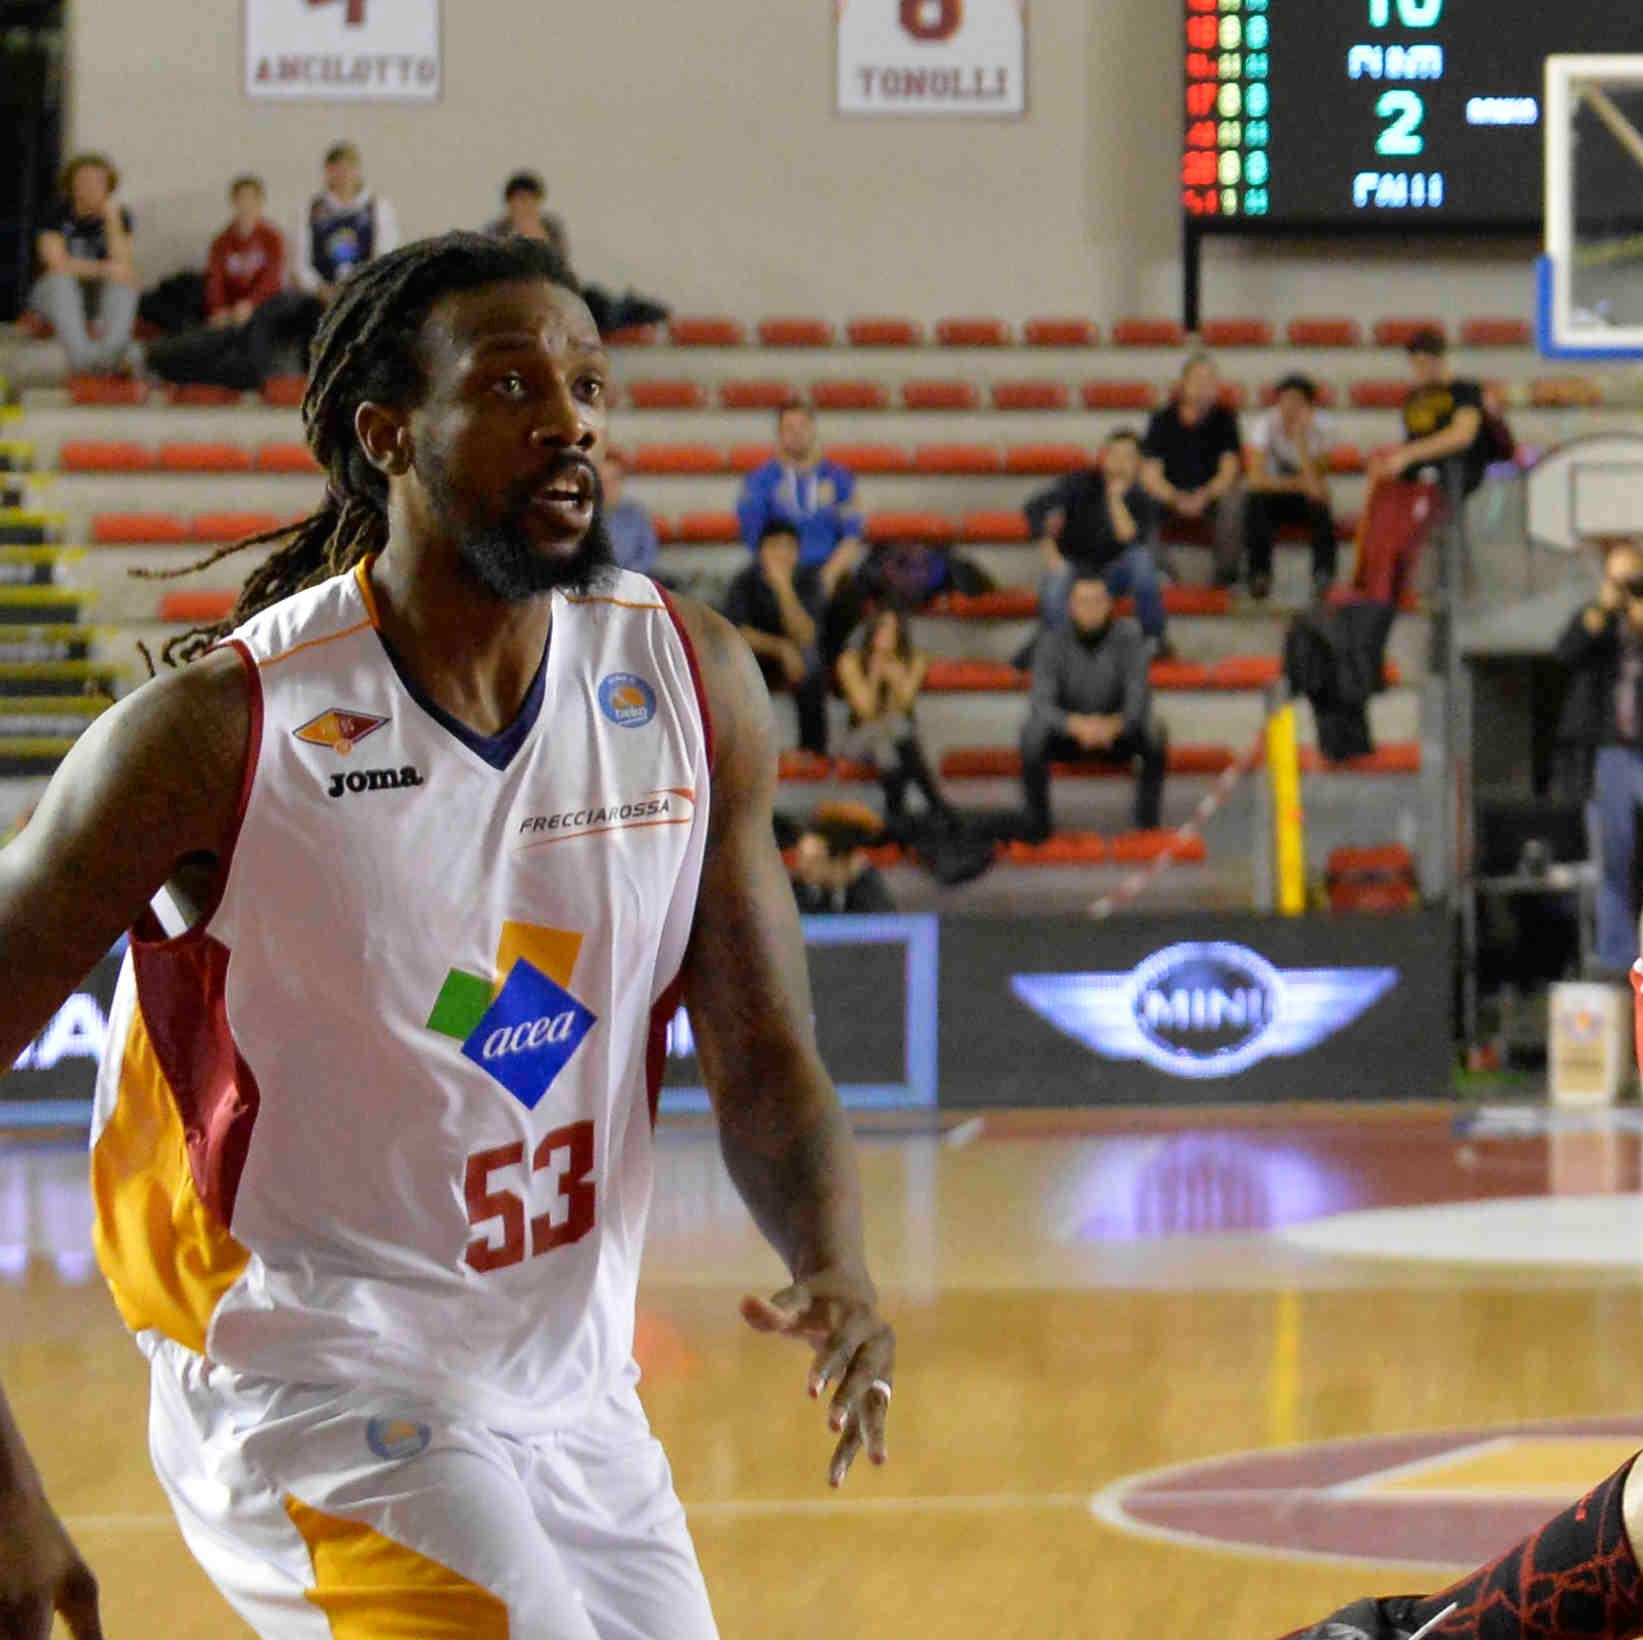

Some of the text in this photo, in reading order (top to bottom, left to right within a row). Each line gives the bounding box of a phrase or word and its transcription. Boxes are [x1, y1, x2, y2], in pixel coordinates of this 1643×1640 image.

[858, 64, 1009, 99] TONOLLI
[1374, 89, 1425, 157] 2
[328, 765, 424, 798] Joma
[519, 798, 673, 834] FRECCIAROSSA
[1145, 987, 1263, 1031] MINI
[482, 1010, 576, 1060] acea
[464, 1120, 597, 1274] 53
